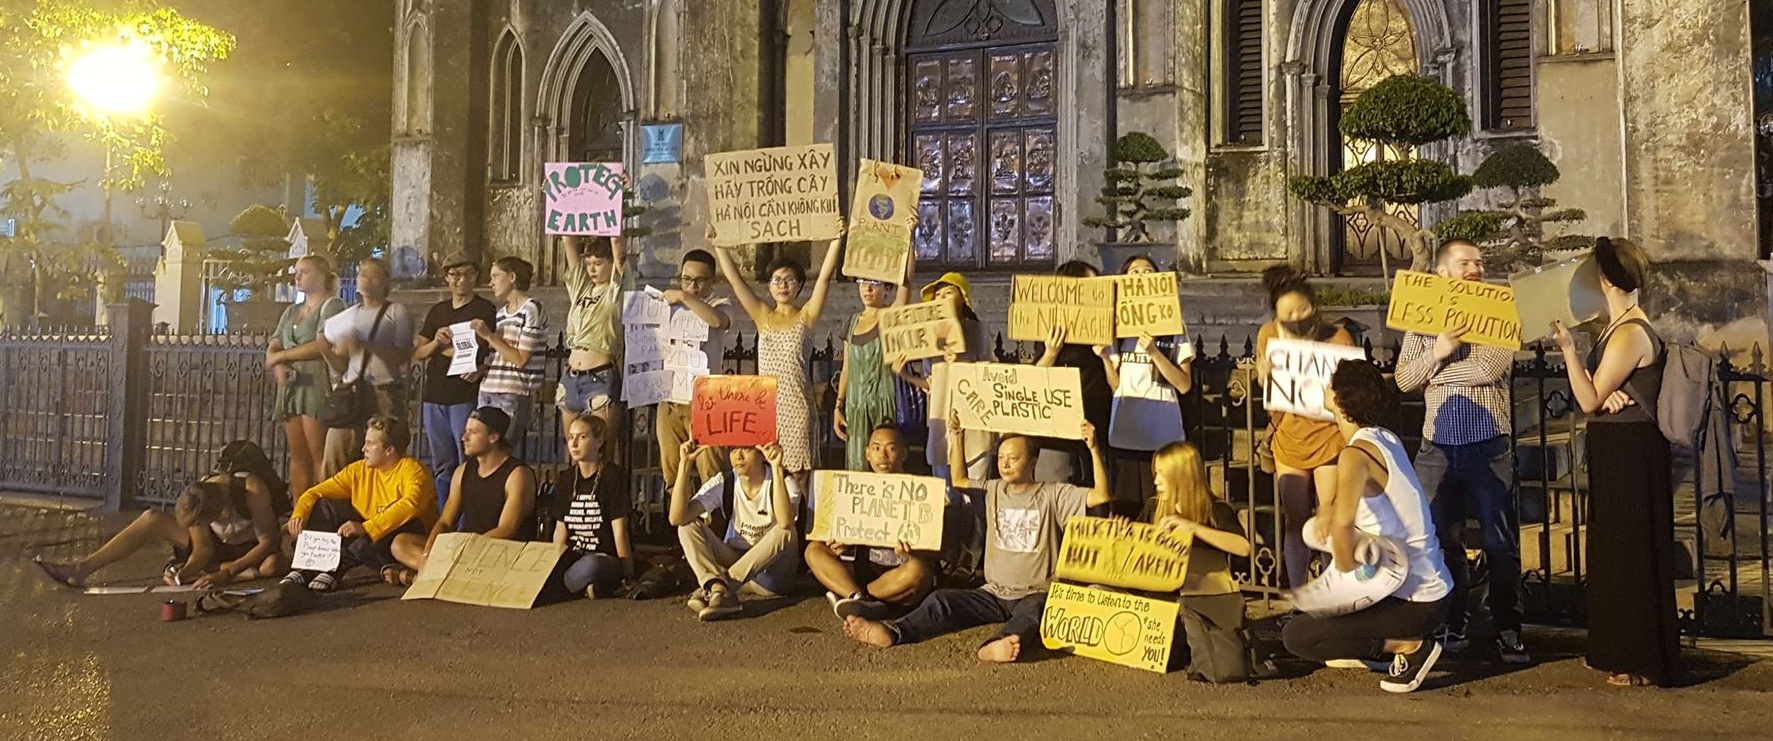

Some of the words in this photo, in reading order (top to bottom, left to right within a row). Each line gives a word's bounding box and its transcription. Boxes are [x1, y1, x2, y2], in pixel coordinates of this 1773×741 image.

[713, 160, 740, 178] XIN
[797, 148, 831, 171] XÂY
[543, 163, 624, 203] PROTECT
[714, 179, 743, 201] HÃY
[797, 173, 829, 194] CÂY
[547, 208, 618, 233] EARTH
[733, 201, 756, 224] NỘI
[787, 197, 820, 216] KHÔNG
[858, 217, 902, 235] PLANT
[1015, 277, 1085, 306] WELCOME
[1147, 272, 1174, 297] NỘI
[1402, 273, 1433, 289] THE
[1448, 279, 1516, 303] SOLUTIO
[1389, 299, 1435, 325] LESS
[1439, 294, 1460, 307] IS
[982, 366, 1018, 385] Avoid
[957, 378, 995, 427] CARE
[992, 400, 1052, 420] PLASTIC
[1044, 388, 1073, 409] USE
[705, 410, 758, 436] LIFE
[833, 473, 877, 497] There
[881, 479, 895, 500] is
[898, 480, 929, 502] NO
[851, 495, 915, 521] PLANET
[917, 502, 934, 524] B
[835, 516, 891, 542] Protect
[1066, 543, 1104, 569] BUT
[464, 566, 485, 577] NOT
[1050, 583, 1065, 600] It's
[1064, 586, 1085, 603] time
[1087, 590, 1096, 605] to
[1122, 595, 1132, 610] to
[1134, 599, 1151, 613] the
[1144, 631, 1166, 645] needs
